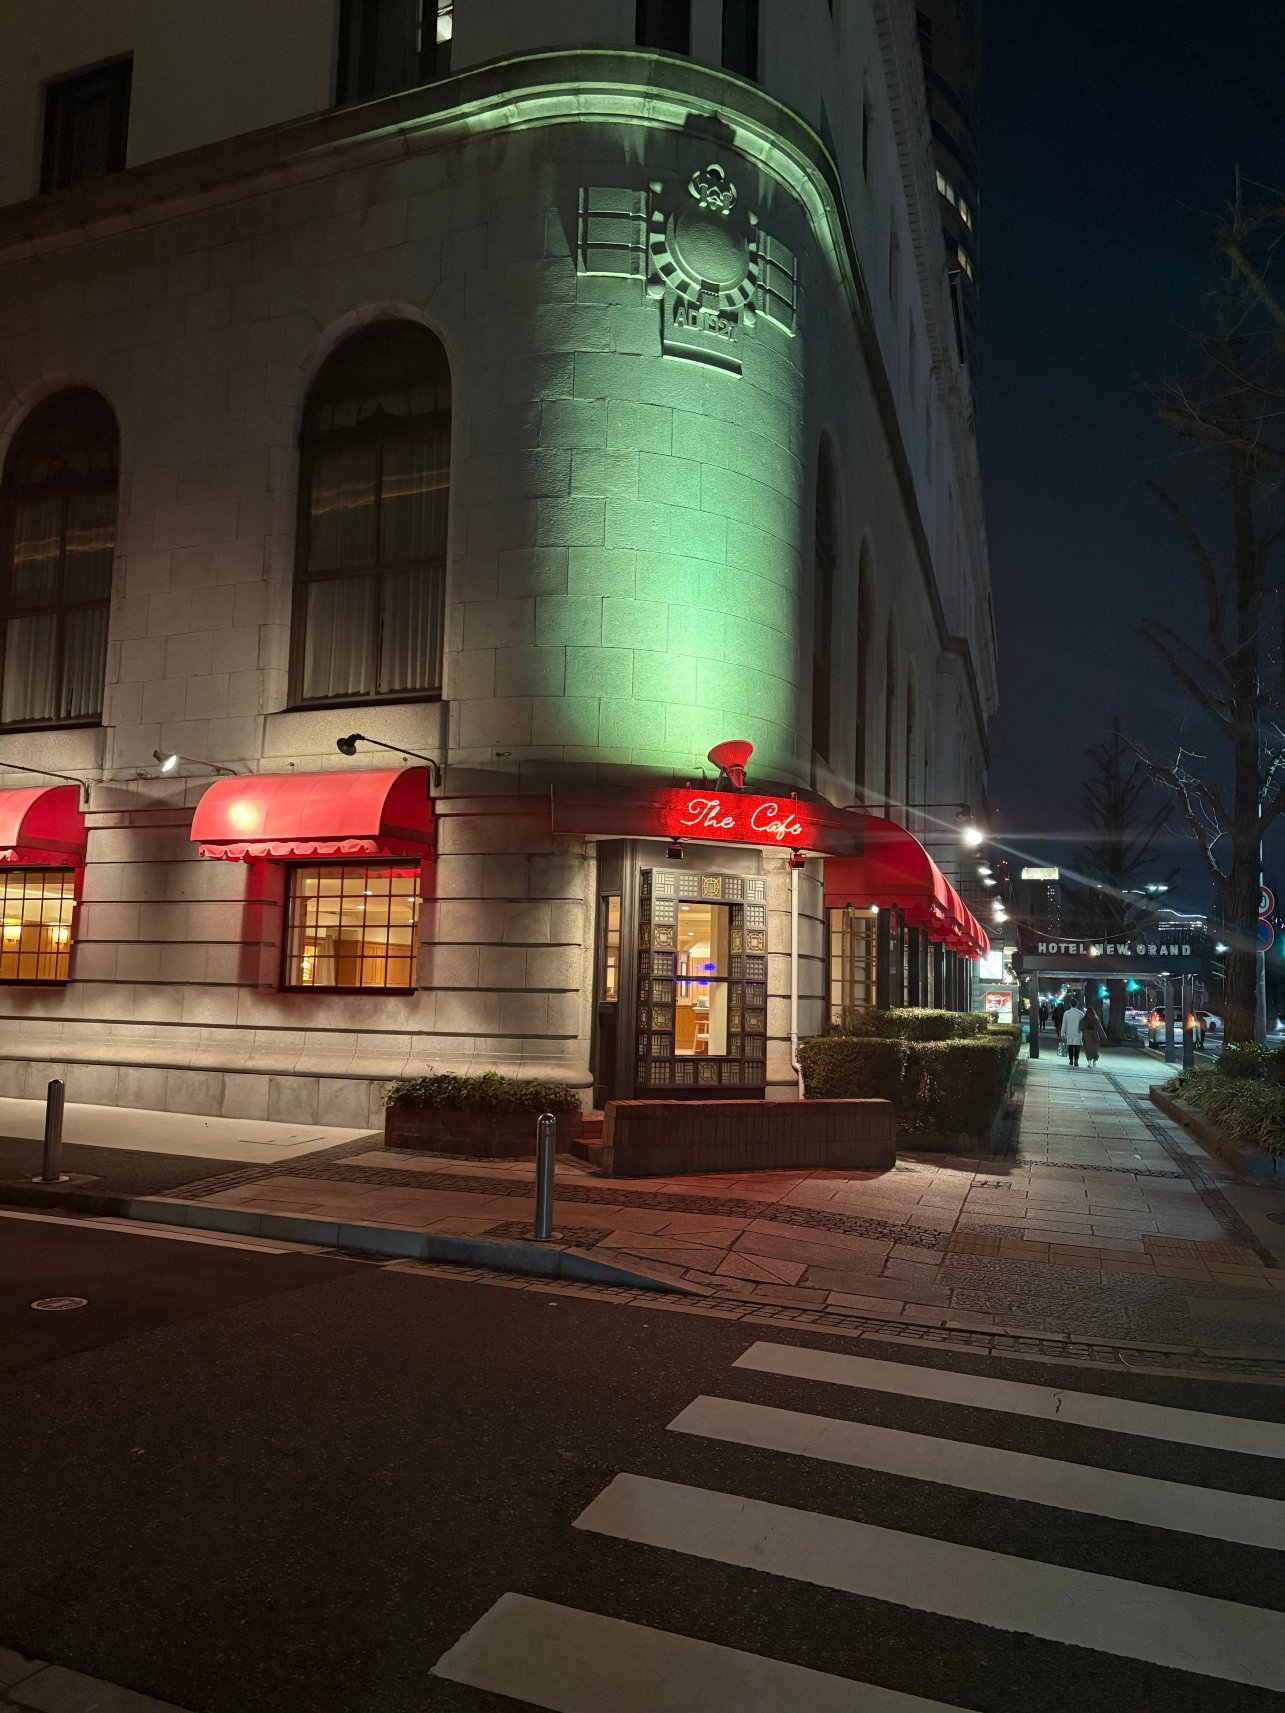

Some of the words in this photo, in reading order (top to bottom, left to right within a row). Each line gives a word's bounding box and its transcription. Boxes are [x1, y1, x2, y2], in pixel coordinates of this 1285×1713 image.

[679, 798, 736, 828] The
[751, 802, 803, 840] Cafe
[1038, 942, 1087, 954] HOTEL
[1093, 943, 1130, 955] NEW
[1136, 943, 1192, 956] GRAND
